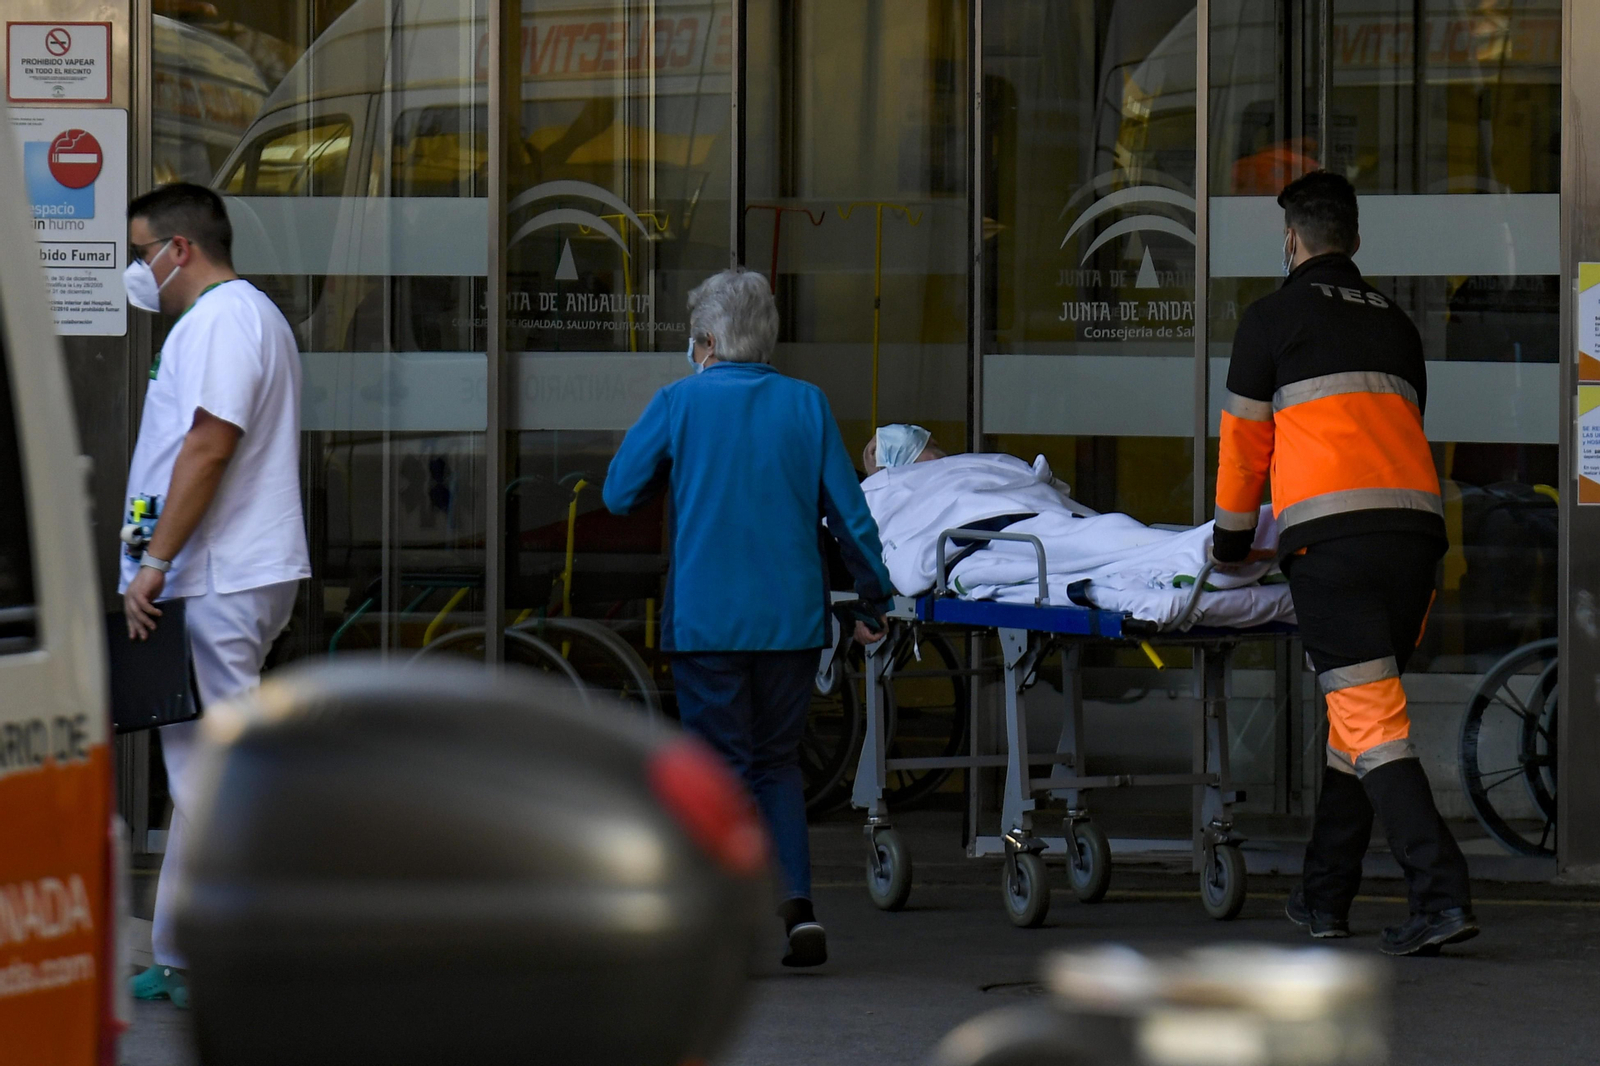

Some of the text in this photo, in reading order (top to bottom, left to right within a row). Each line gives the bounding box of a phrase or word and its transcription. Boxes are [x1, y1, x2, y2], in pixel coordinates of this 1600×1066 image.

[21, 58, 95, 66] PROHIBIDO VAPEAR
[33, 217, 85, 230] in humo
[40, 249, 111, 261] bido Fumar
[539, 292, 558, 311] DE
[1311, 283, 1389, 309] TES
[1059, 302, 1111, 321] JUNTA
[1119, 302, 1139, 321] DE
[1156, 326, 1172, 338] de
[1176, 326, 1195, 338] Sal
